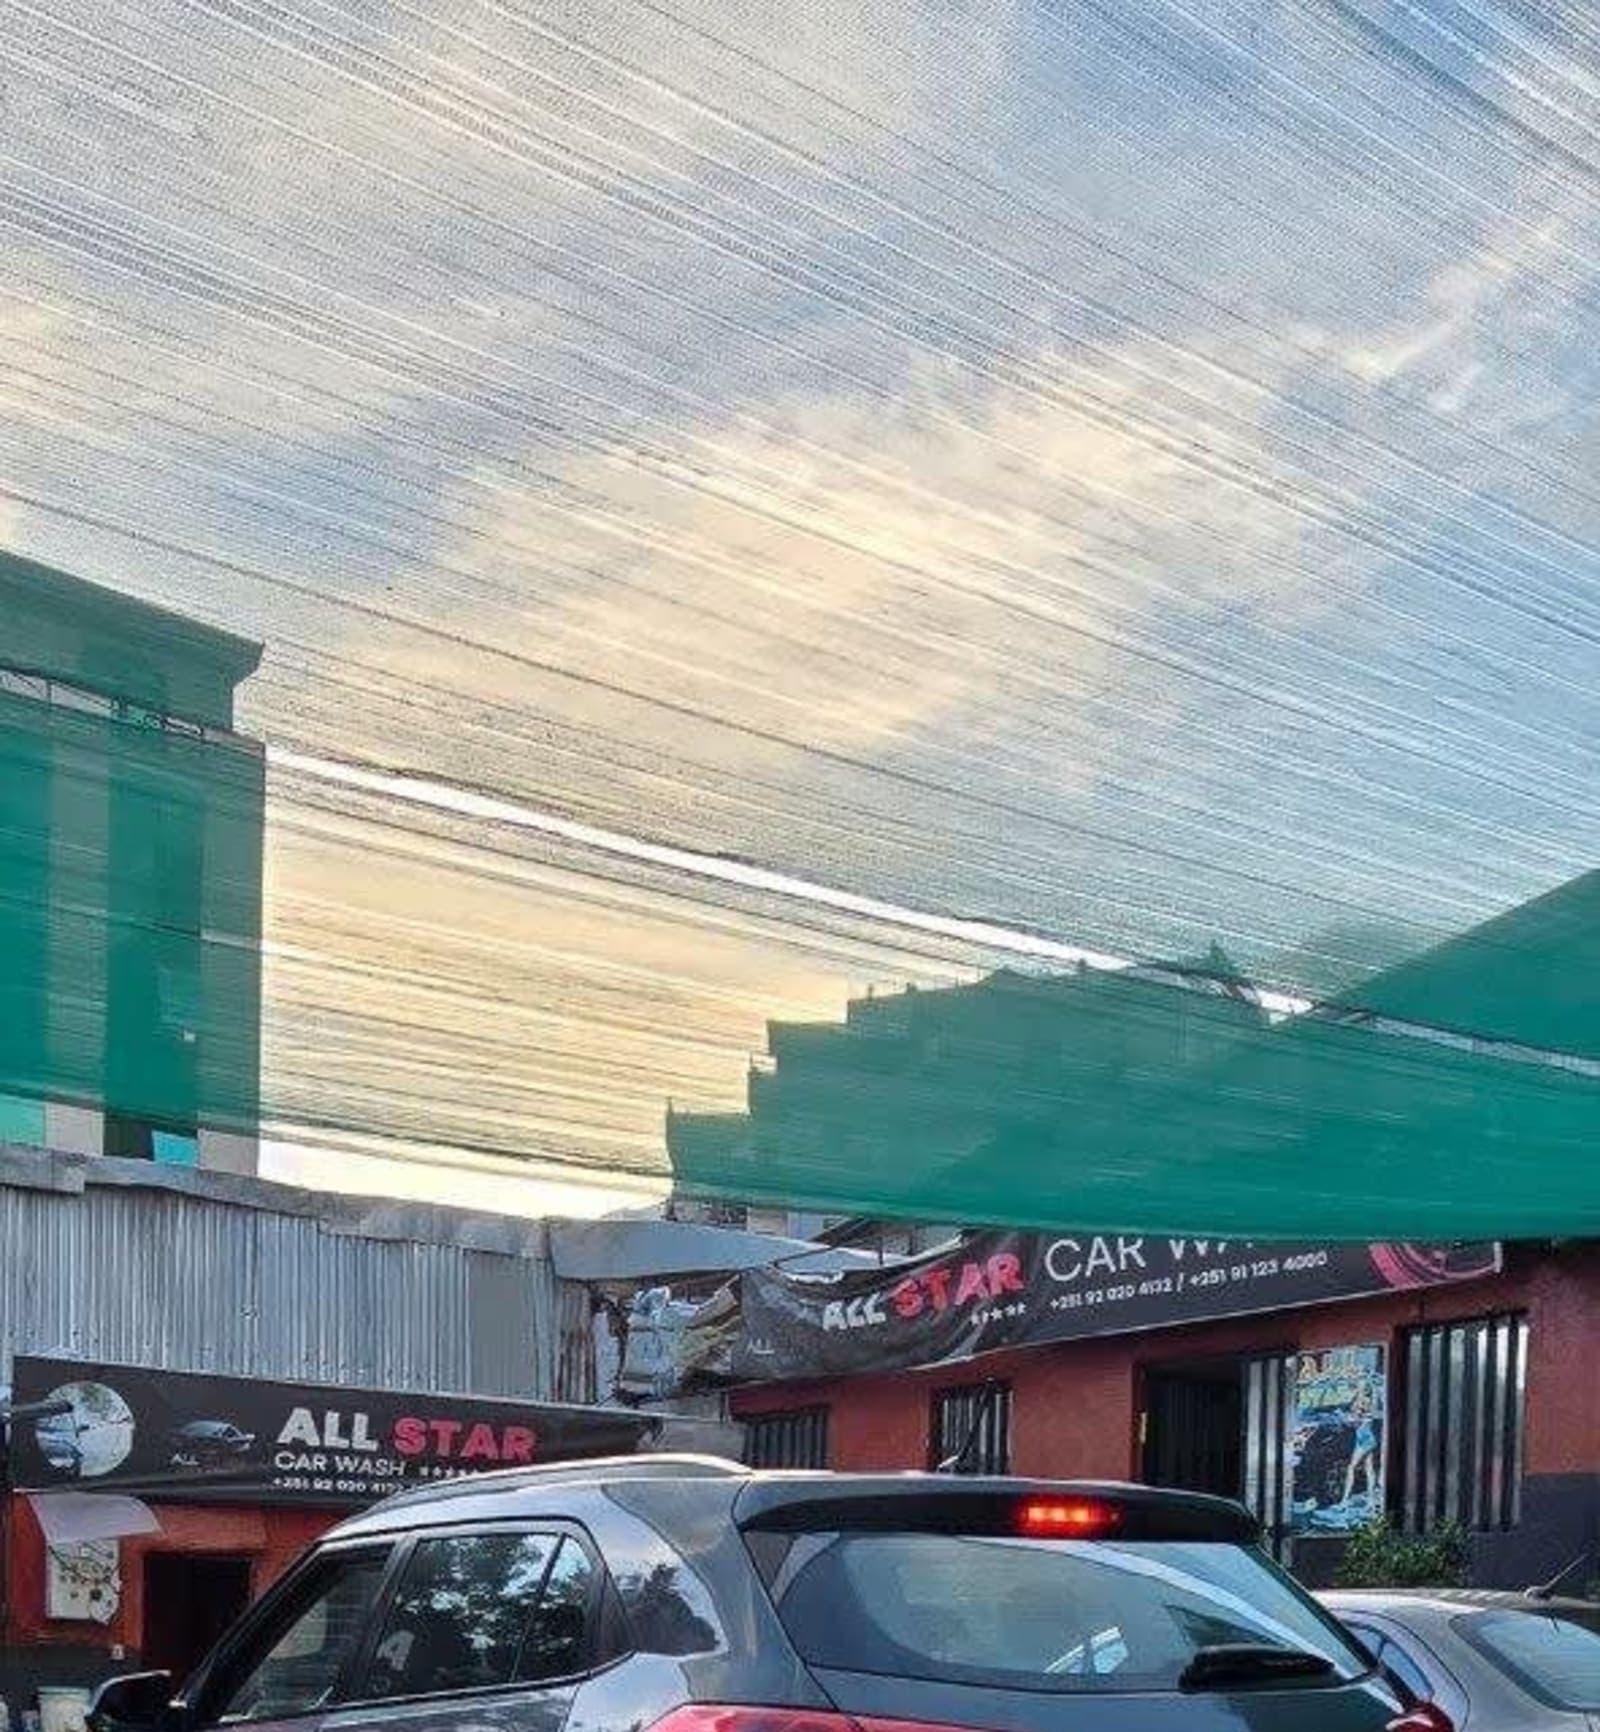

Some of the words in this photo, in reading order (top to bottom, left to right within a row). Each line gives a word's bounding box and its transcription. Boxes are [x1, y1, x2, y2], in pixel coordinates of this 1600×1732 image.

[1044, 1236, 1146, 1281] CAR
[1085, 1290, 1104, 1305] 92
[1190, 1268, 1227, 1286] +251
[1231, 1264, 1247, 1280] 91
[1251, 1259, 1279, 1277] 123
[1283, 1250, 1328, 1271] 4000
[823, 1294, 885, 1331] ALL
[893, 1253, 1024, 1317] STAR
[275, 1406, 379, 1452] ALL
[393, 1416, 537, 1462] STAR
[275, 1450, 328, 1471] CAR
[335, 1455, 406, 1476] WASH
